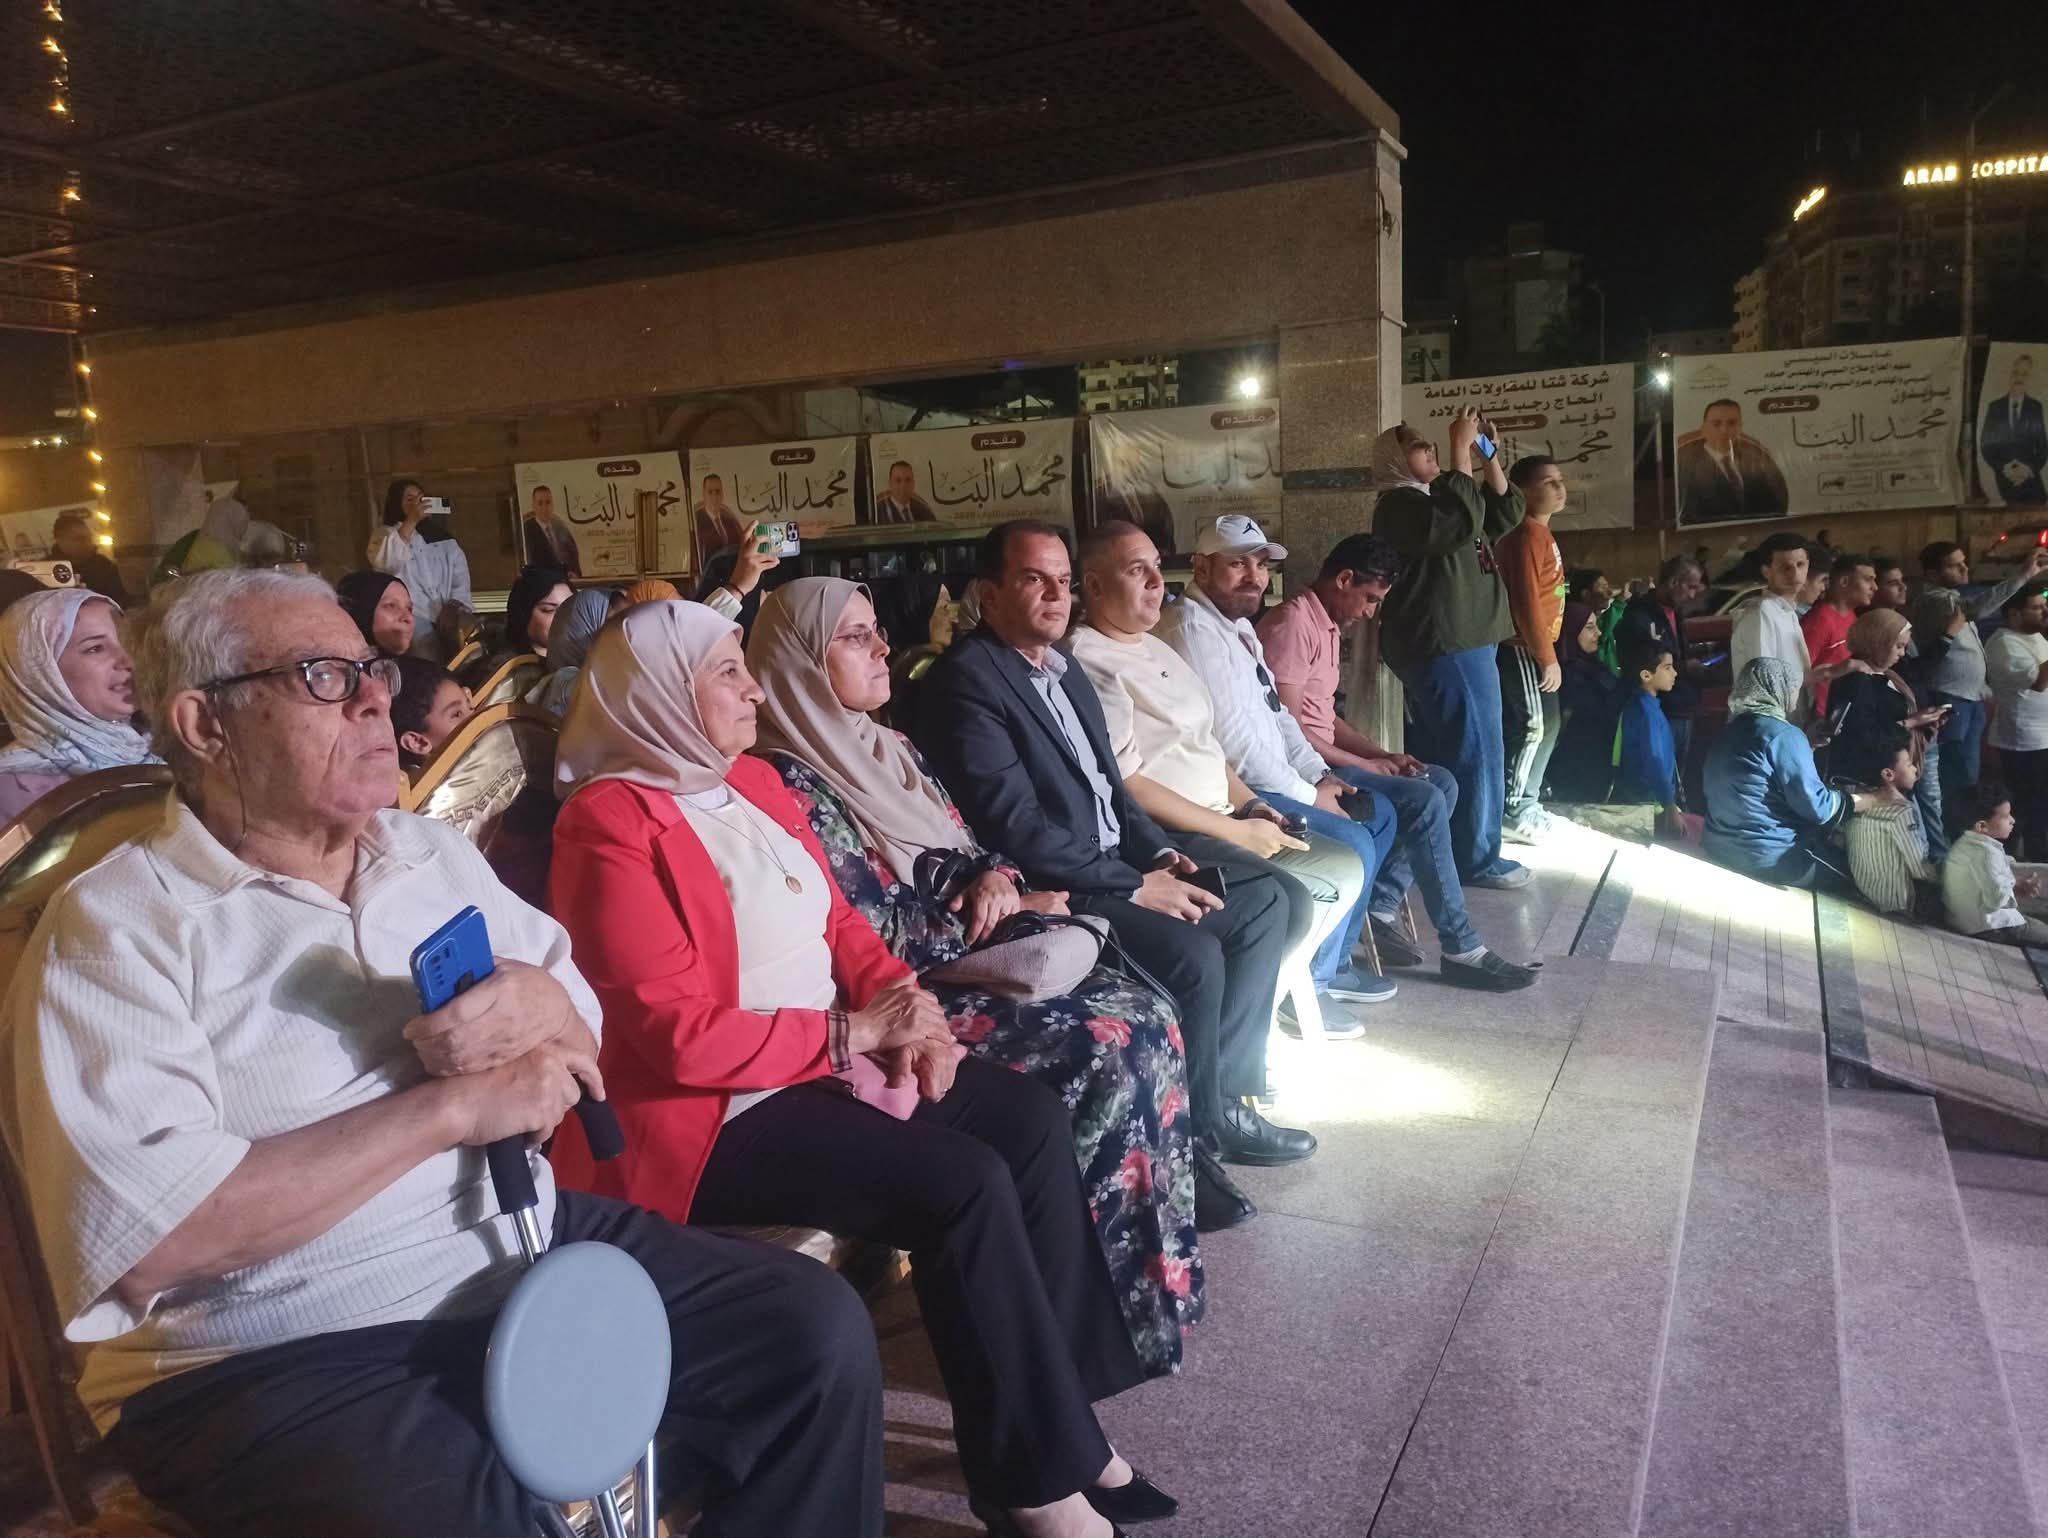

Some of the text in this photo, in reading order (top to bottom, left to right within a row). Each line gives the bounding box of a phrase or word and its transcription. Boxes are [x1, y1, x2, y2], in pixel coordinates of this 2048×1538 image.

[1424, 371, 1609, 399] شركة شتا للمقاولات العامة
[1513, 398, 1550, 413] رجب
[1553, 392, 1603, 411] الحاج
[1222, 414, 1265, 426] مقدم
[1559, 407, 1616, 427] تؤيد
[1792, 408, 1948, 449] محمد البنا
[980, 434, 1017, 448] مقدم
[603, 464, 635, 475] مقدم
[928, 454, 1066, 509] محمد البنا
[734, 470, 848, 518] محمد البنا
[563, 482, 621, 527] البنا
